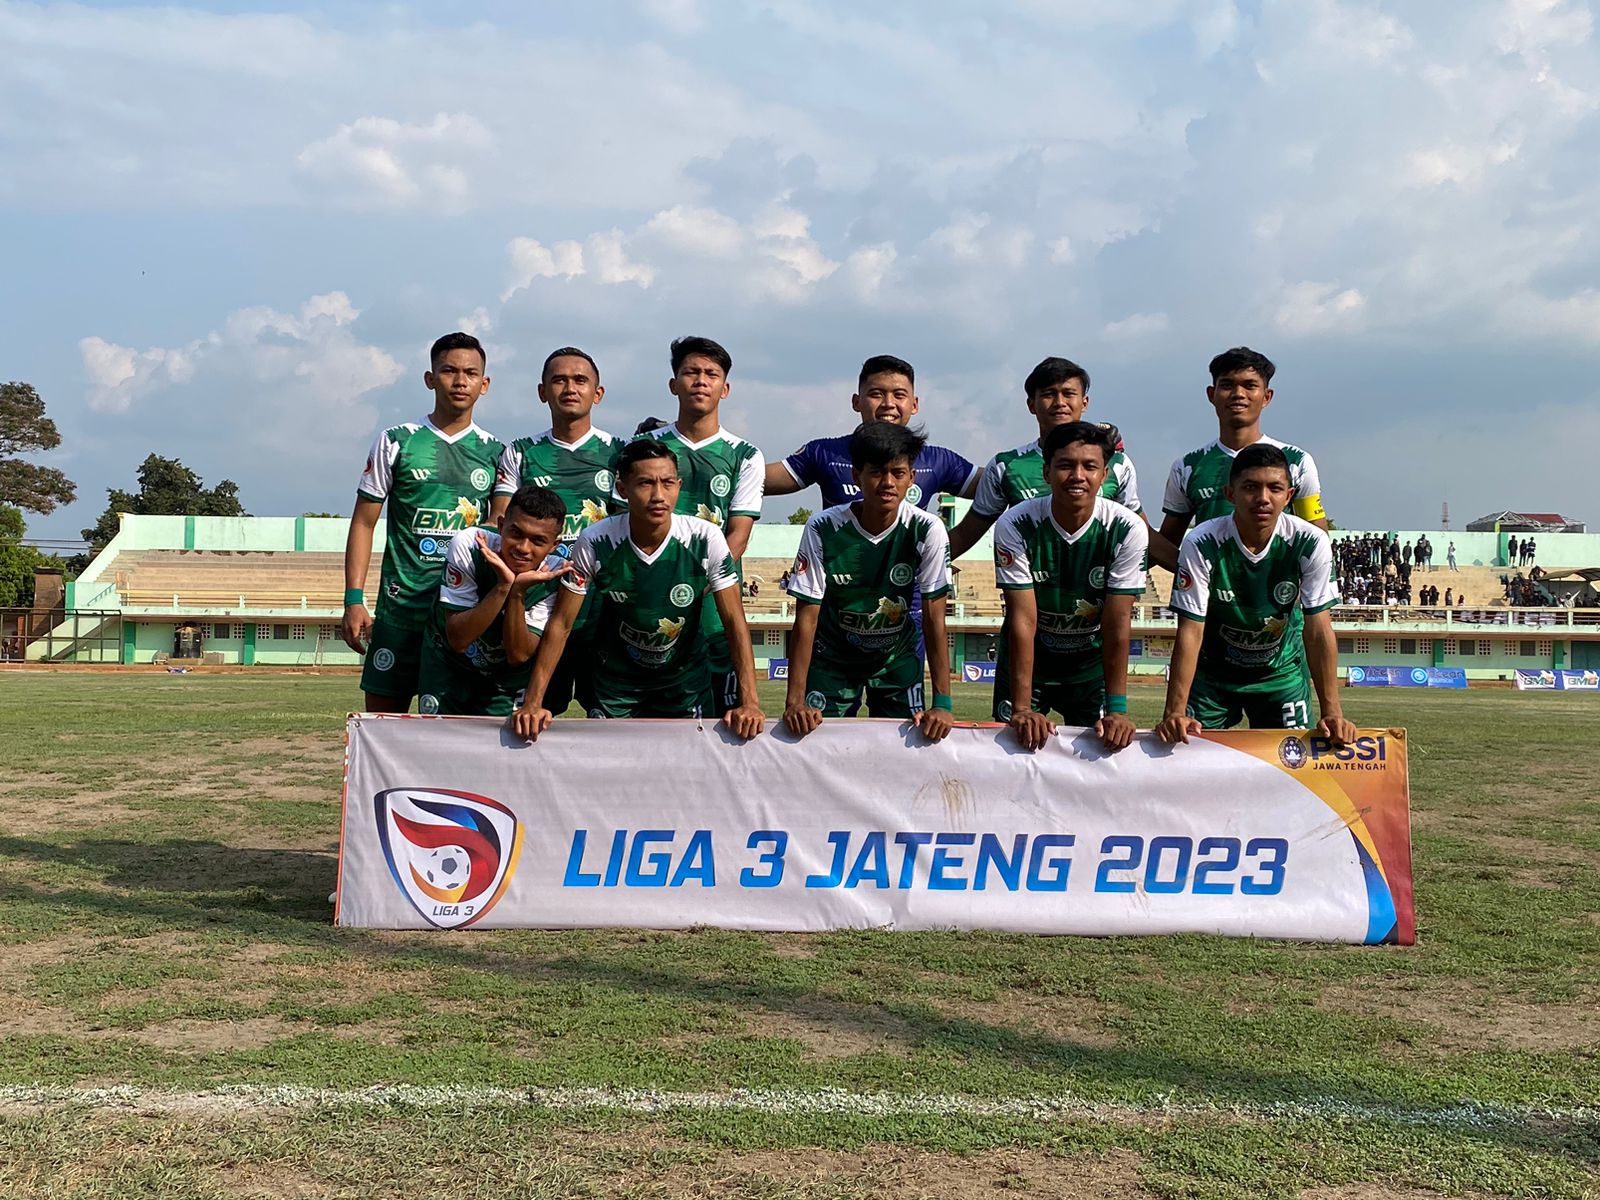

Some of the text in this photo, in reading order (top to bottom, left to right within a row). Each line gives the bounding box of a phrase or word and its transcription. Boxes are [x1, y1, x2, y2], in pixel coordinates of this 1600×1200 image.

[983, 669, 995, 677] LIG
[1282, 700, 1309, 727] 27
[563, 829, 1289, 896] LIGA 3 JATENG 2023
[432, 906, 475, 916] LIGA 3
